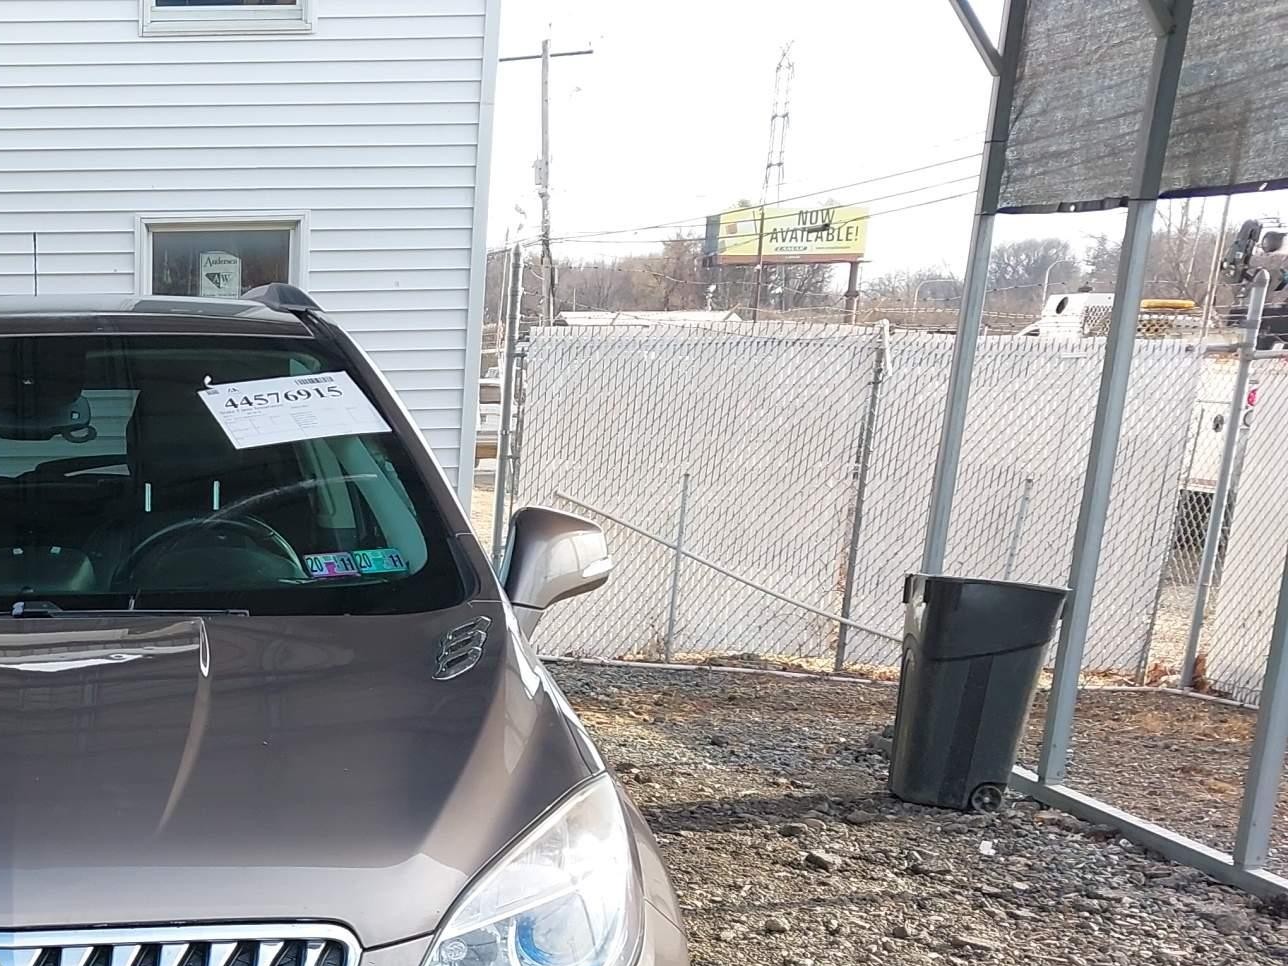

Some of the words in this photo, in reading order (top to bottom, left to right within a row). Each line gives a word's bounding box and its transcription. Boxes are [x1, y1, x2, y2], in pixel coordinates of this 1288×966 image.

[797, 209, 835, 226] NOW
[769, 226, 859, 243] AVAILABLE!
[224, 386, 343, 409] 44576915
[305, 557, 323, 572] 20
[355, 553, 372, 569] 20
